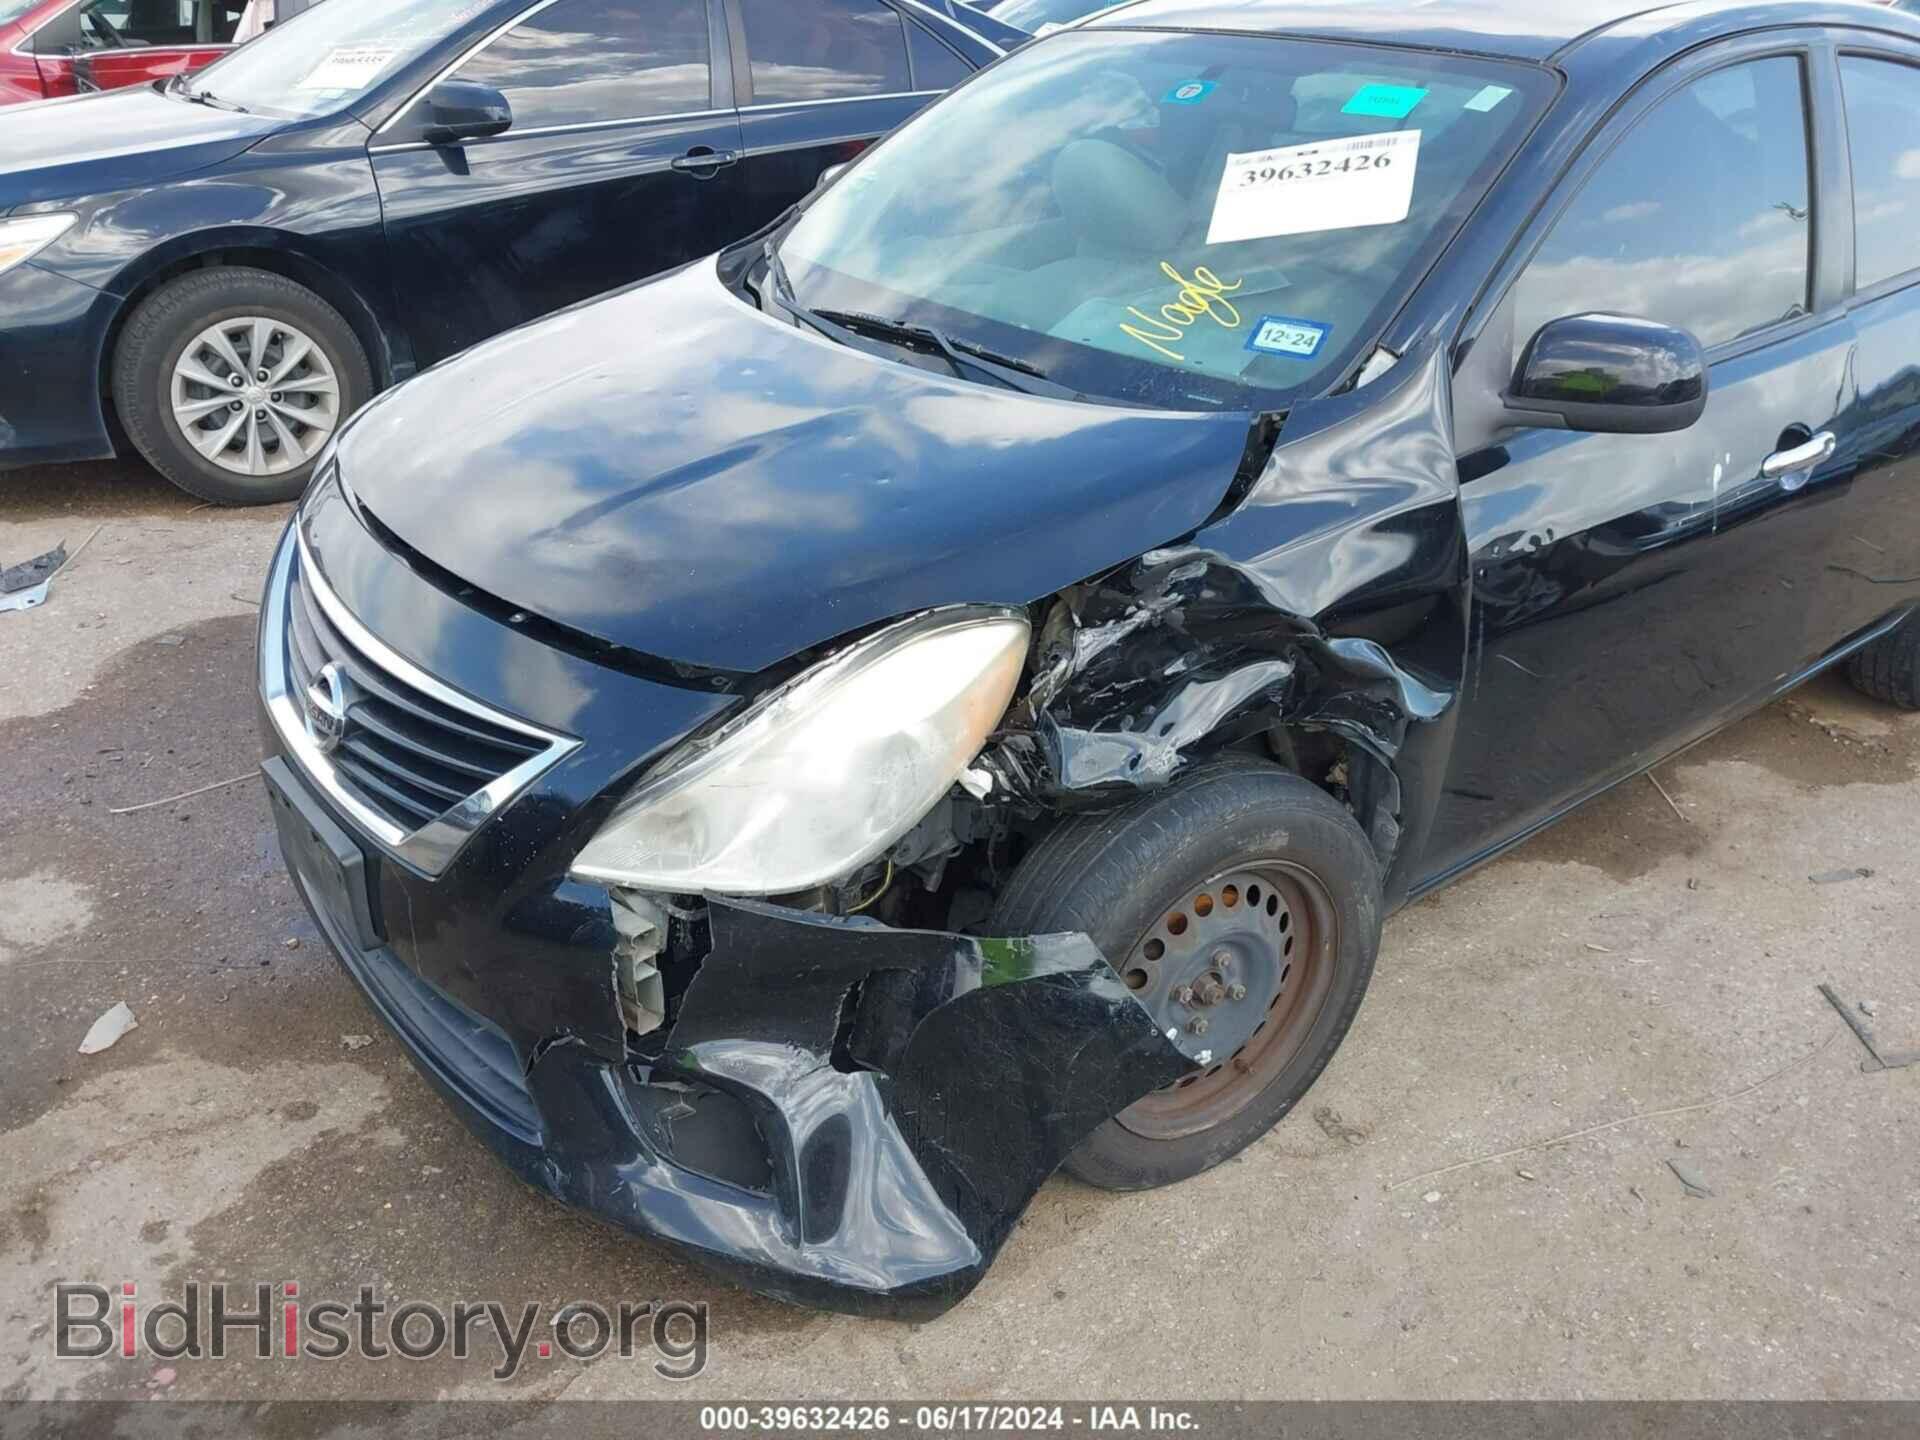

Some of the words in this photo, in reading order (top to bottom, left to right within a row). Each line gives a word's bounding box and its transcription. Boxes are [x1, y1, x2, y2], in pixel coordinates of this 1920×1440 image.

[1239, 151, 1392, 188] 39632426
[1263, 328, 1285, 344] 12
[1291, 332, 1316, 348] 24
